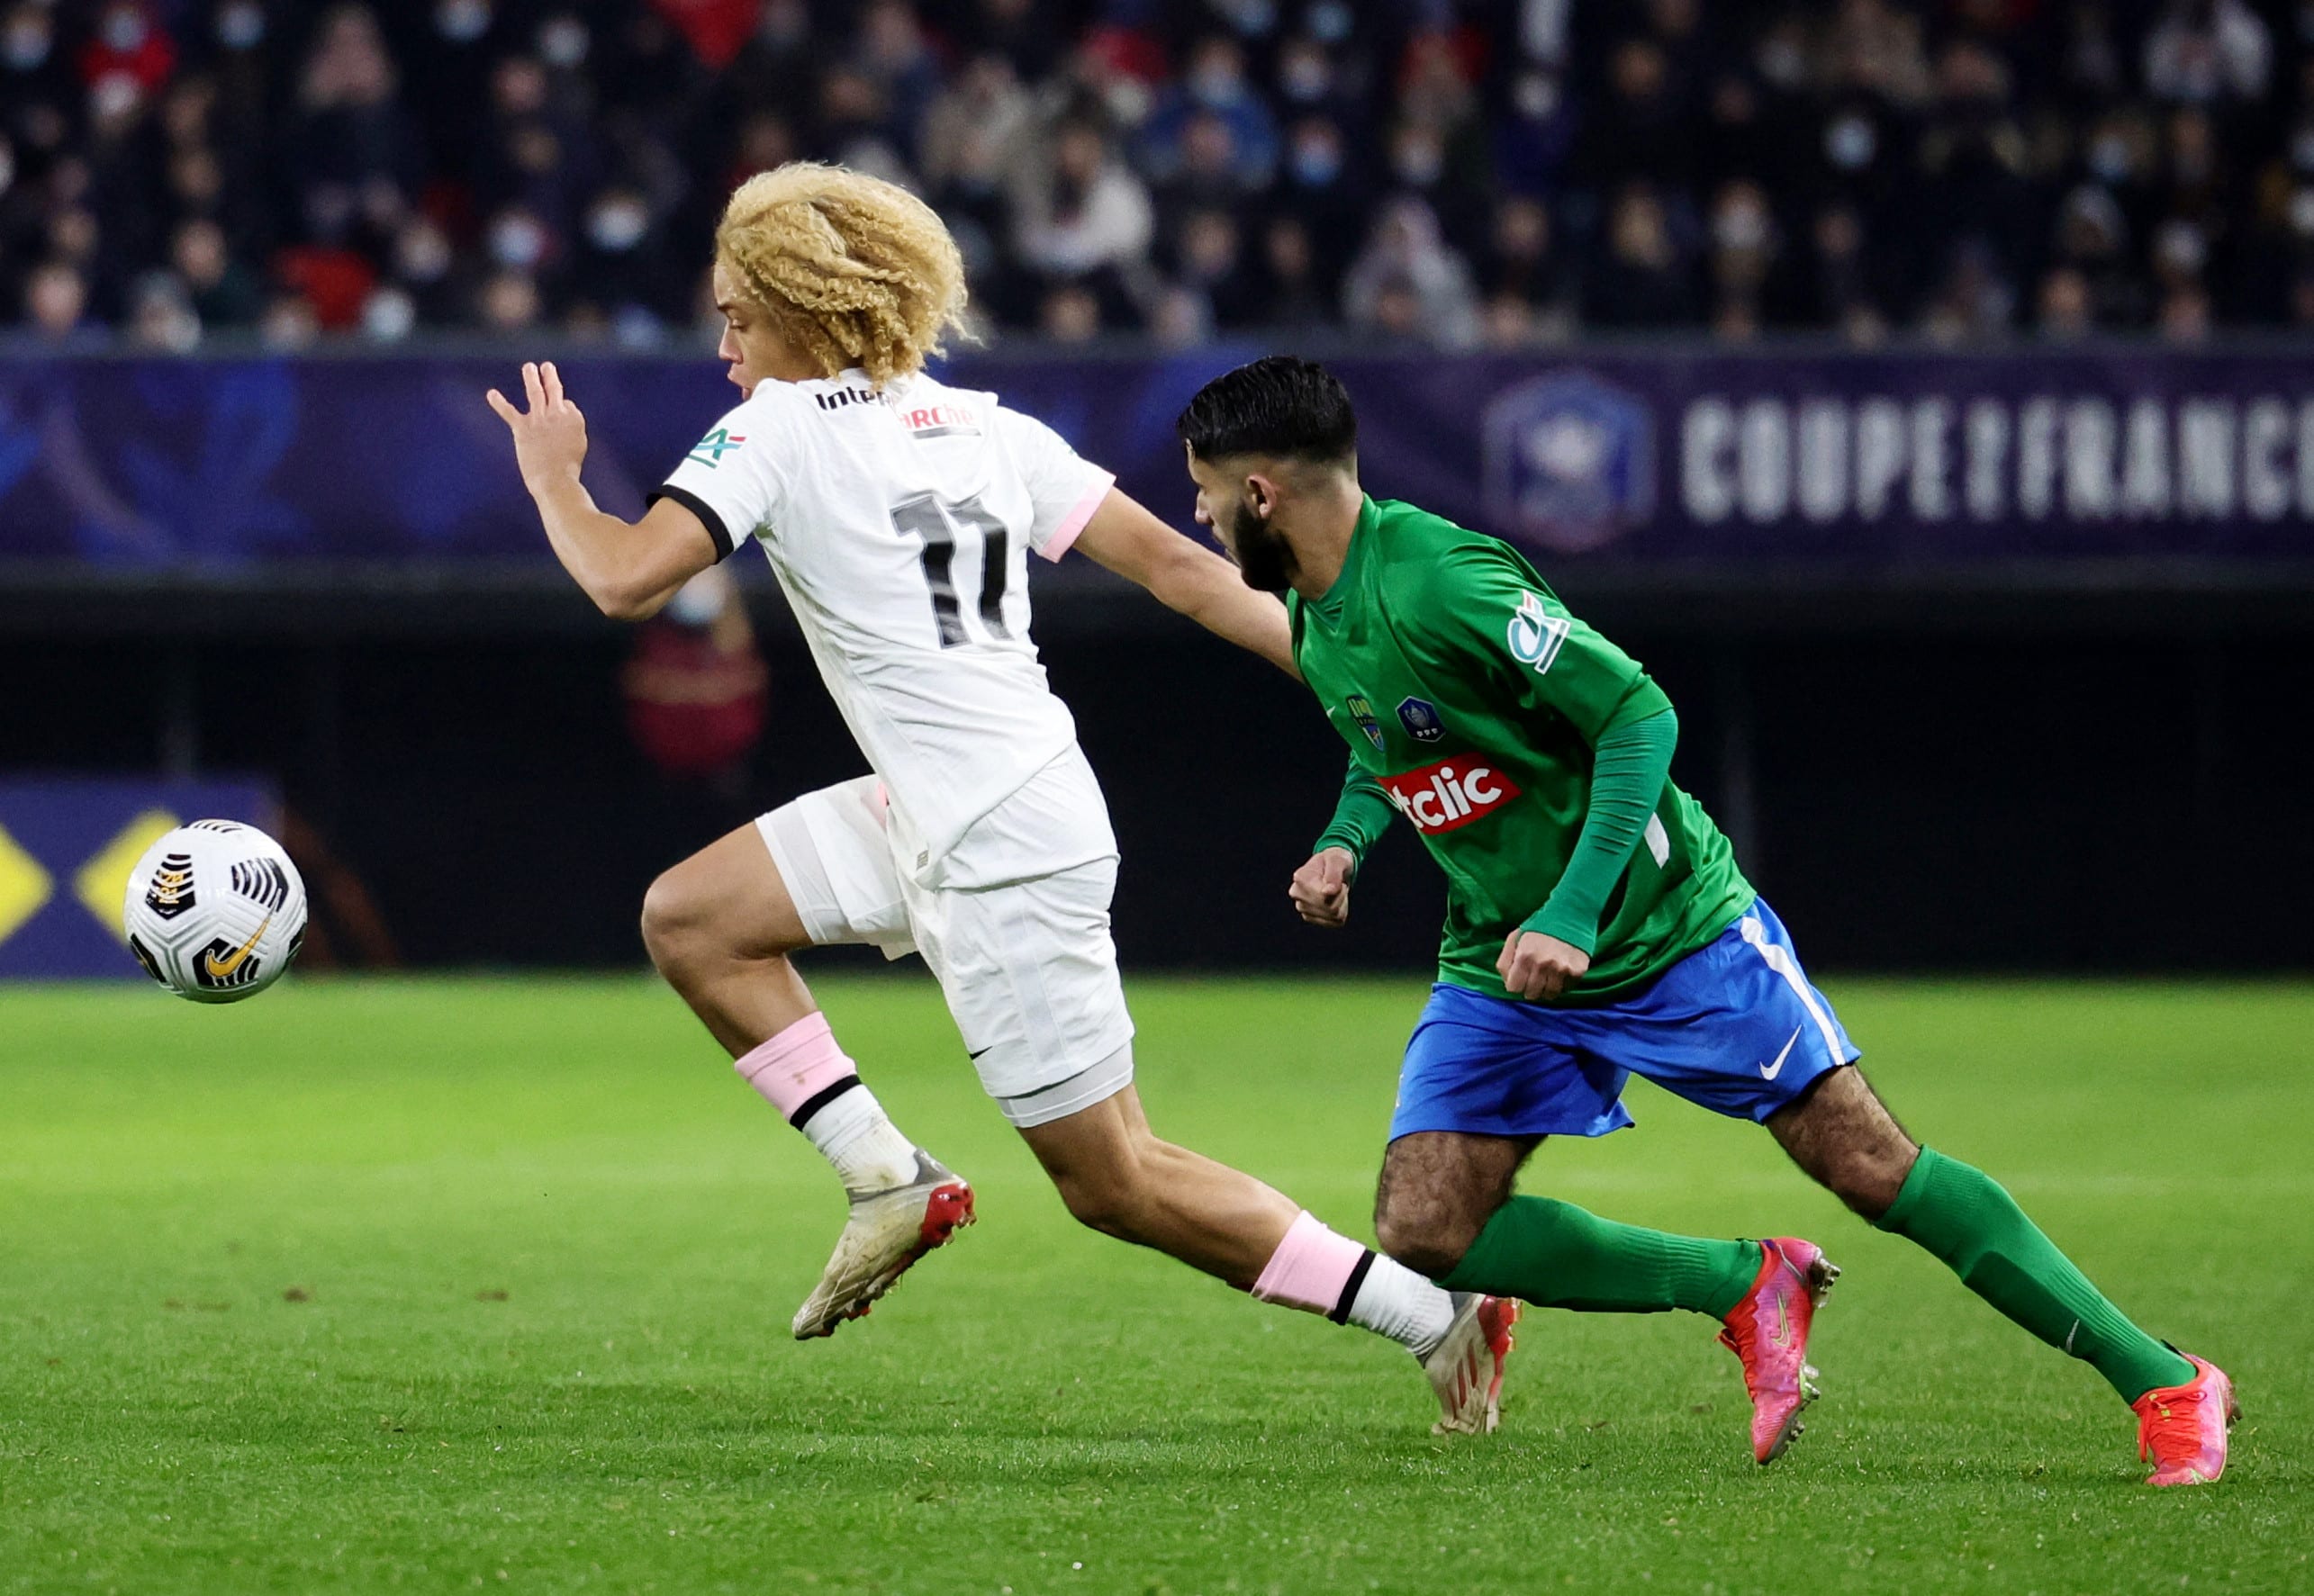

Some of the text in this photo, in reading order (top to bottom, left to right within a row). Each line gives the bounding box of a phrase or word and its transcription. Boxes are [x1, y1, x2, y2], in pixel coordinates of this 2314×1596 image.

[1681, 395, 1954, 522] COUPE
[890, 494, 1014, 650] 11
[1390, 766, 1502, 828] tclic
